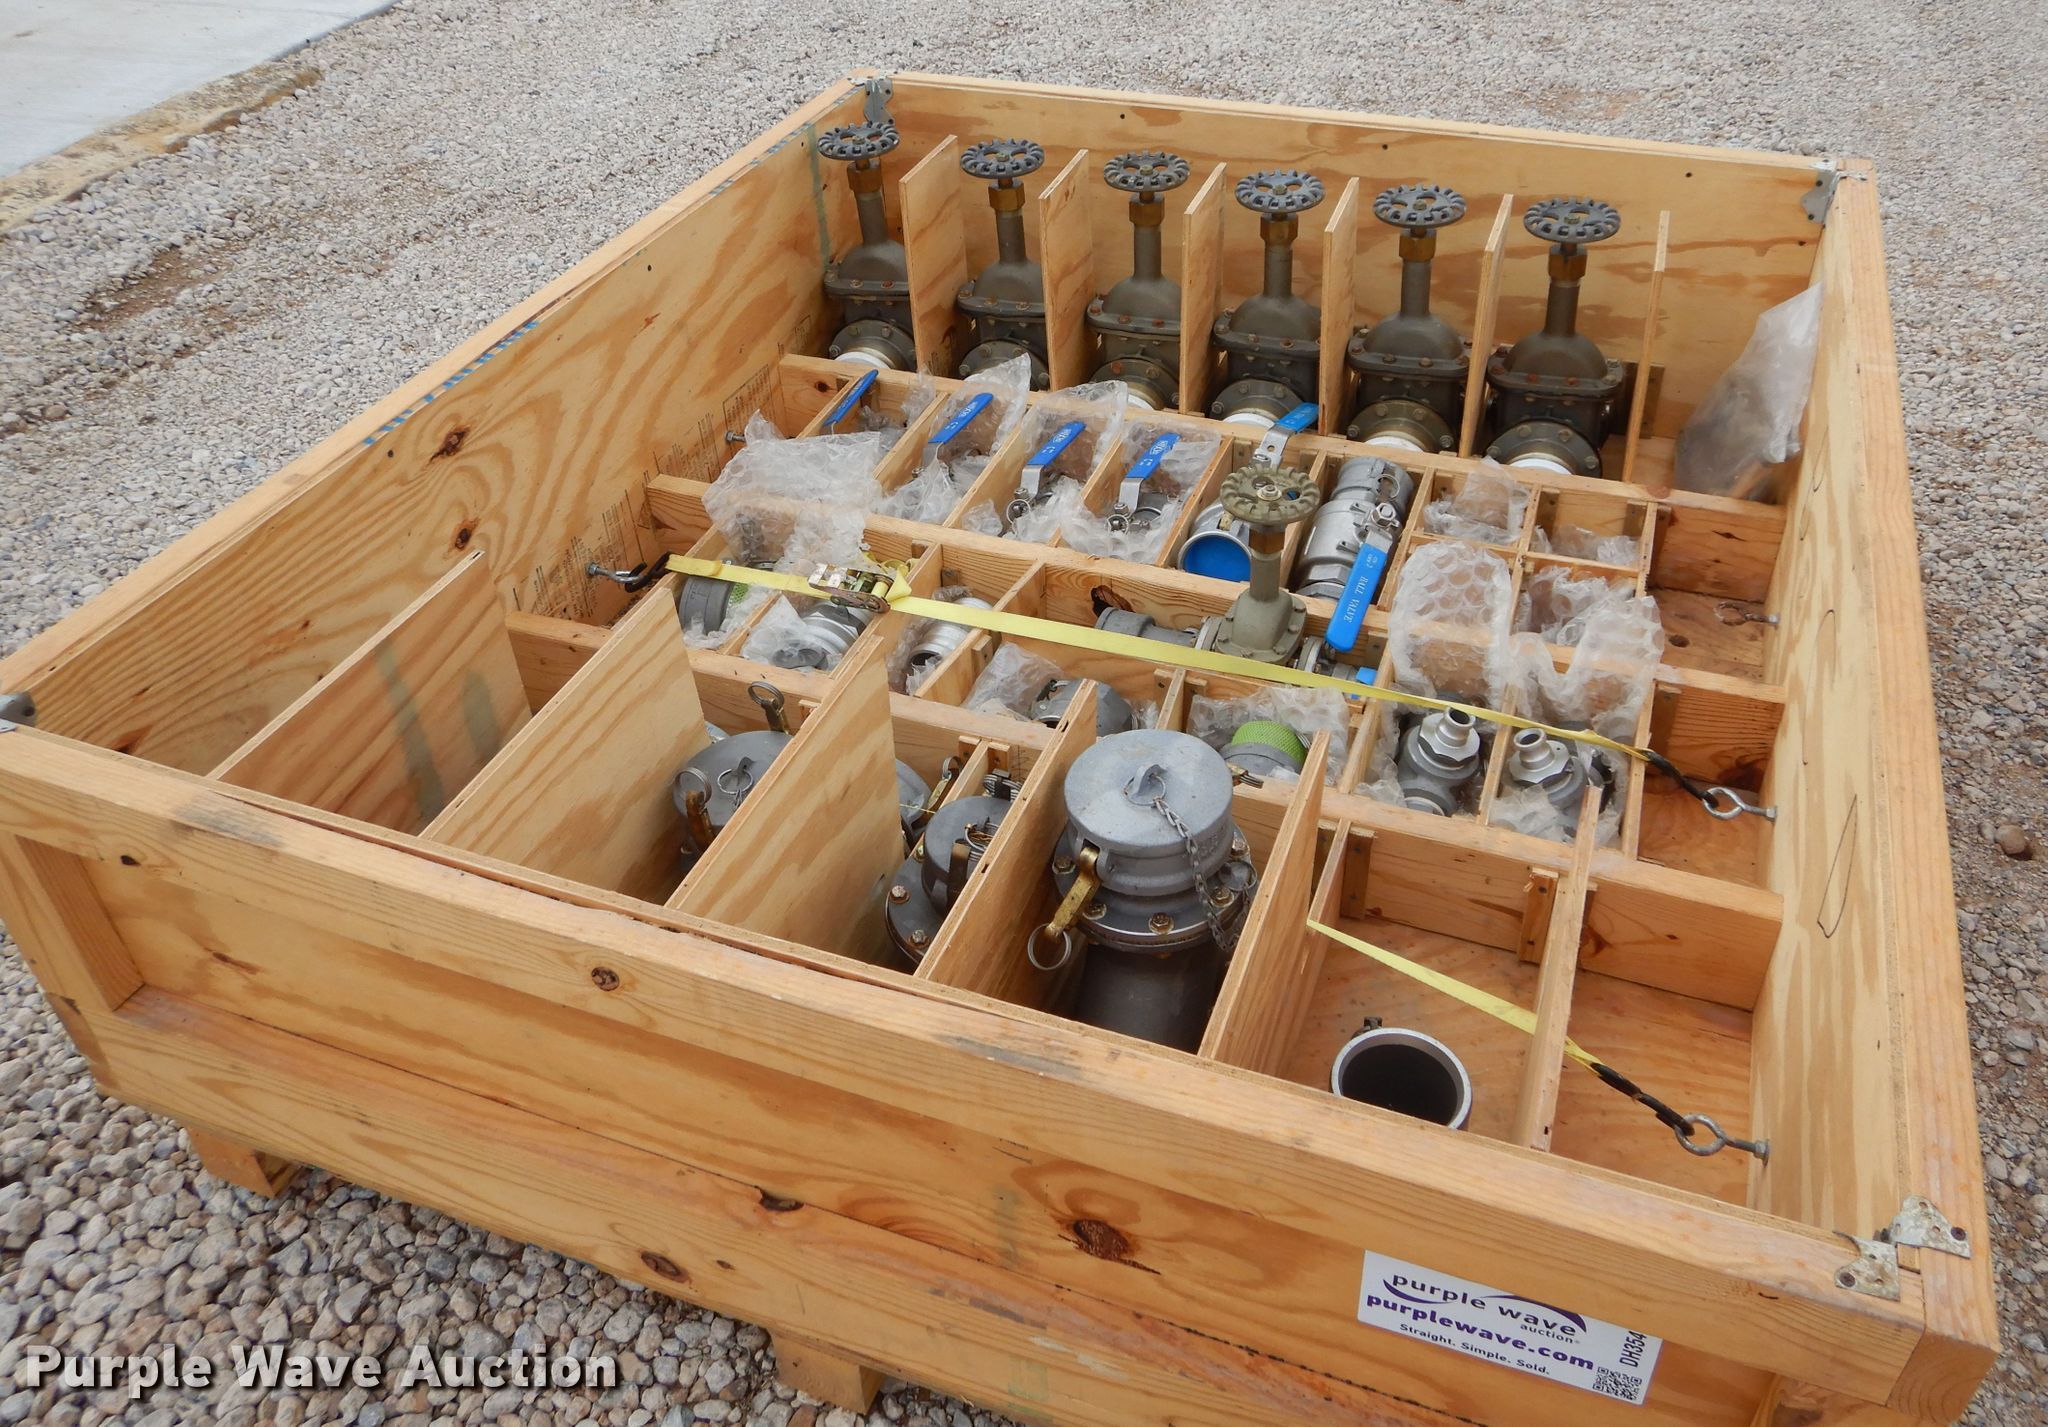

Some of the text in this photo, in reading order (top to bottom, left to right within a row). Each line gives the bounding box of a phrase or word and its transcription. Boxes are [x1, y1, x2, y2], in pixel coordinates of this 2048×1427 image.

[1343, 576, 1369, 623] BALL VALVE
[1392, 1274, 1576, 1337] purple wave
[1367, 1294, 1594, 1371] purplewave.com
[1399, 1323, 1550, 1376] Straight. Simple. Sold.
[1619, 1330, 1648, 1368] DH354
